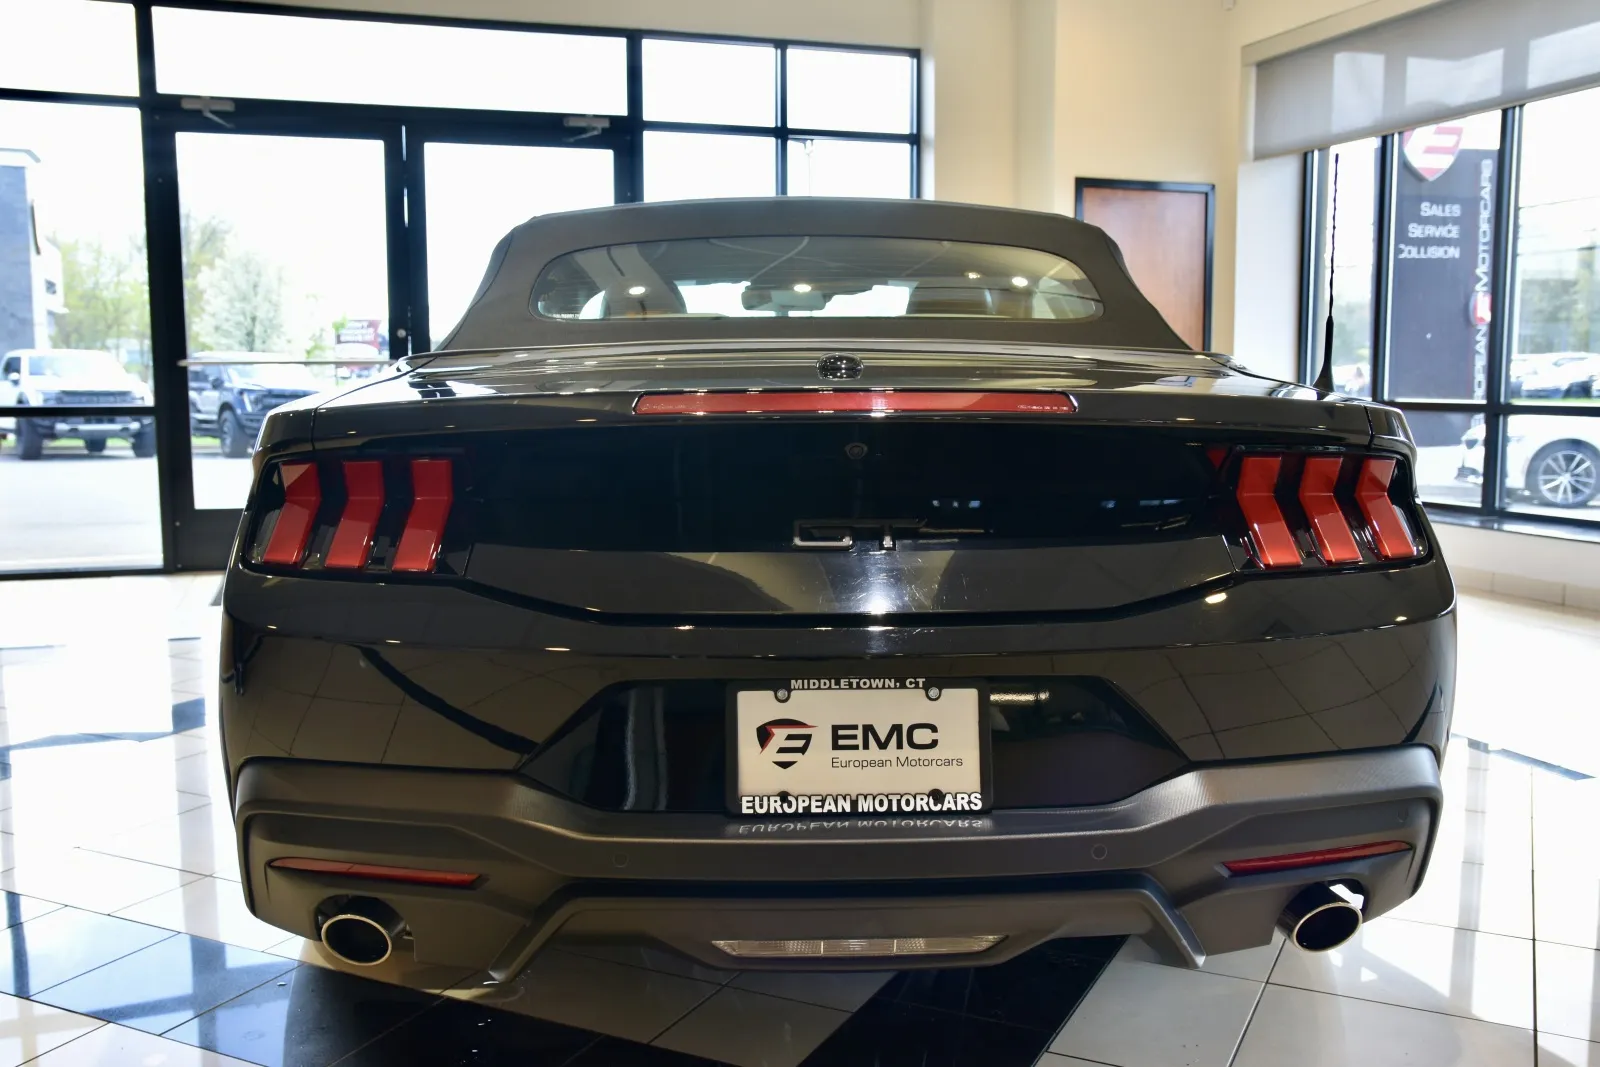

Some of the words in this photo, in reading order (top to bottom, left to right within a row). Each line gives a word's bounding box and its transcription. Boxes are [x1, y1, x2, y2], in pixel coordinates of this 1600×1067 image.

[1420, 201, 1461, 217] SALES
[1408, 222, 1460, 238] SERVICE
[1475, 158, 1493, 291] MOTORCARS
[790, 678, 900, 689] MIDDLETOWN,
[905, 677, 926, 688] CT
[831, 722, 939, 751] EMC
[831, 756, 892, 770] European
[896, 756, 963, 767] Motorcars
[741, 795, 850, 814] EUROPEAN
[858, 792, 983, 812] MOTORCARS
